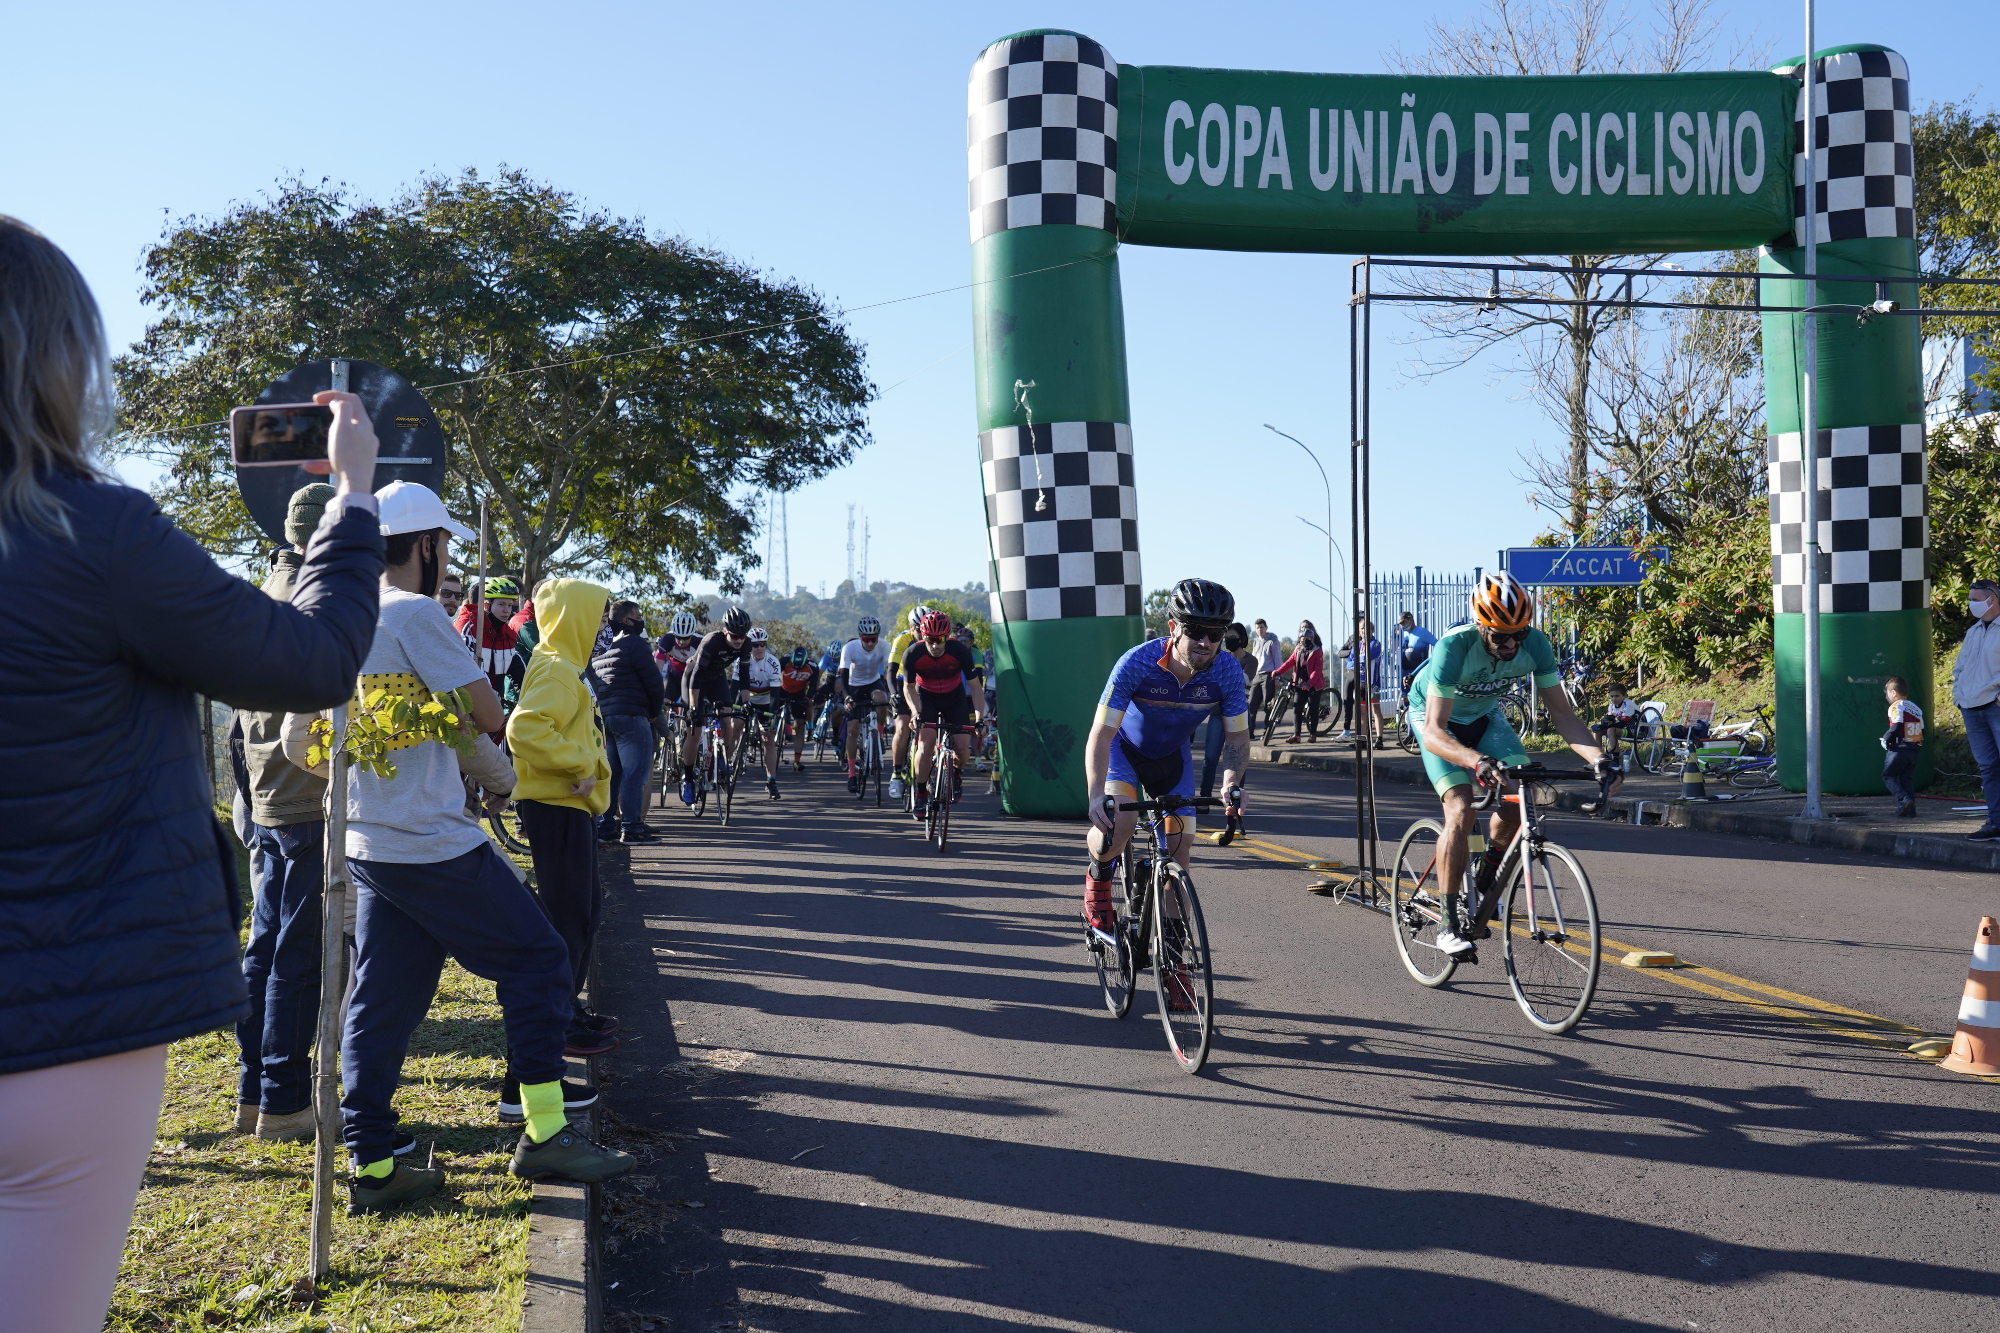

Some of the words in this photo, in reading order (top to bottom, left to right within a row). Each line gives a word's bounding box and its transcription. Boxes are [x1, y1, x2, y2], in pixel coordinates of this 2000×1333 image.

[1163, 99, 1293, 190] COPA
[1309, 92, 1457, 195] UNIÃO
[1474, 112, 1530, 195] DE
[1548, 110, 1765, 196] CICLISMO
[1551, 558, 1624, 576] FACCAT
